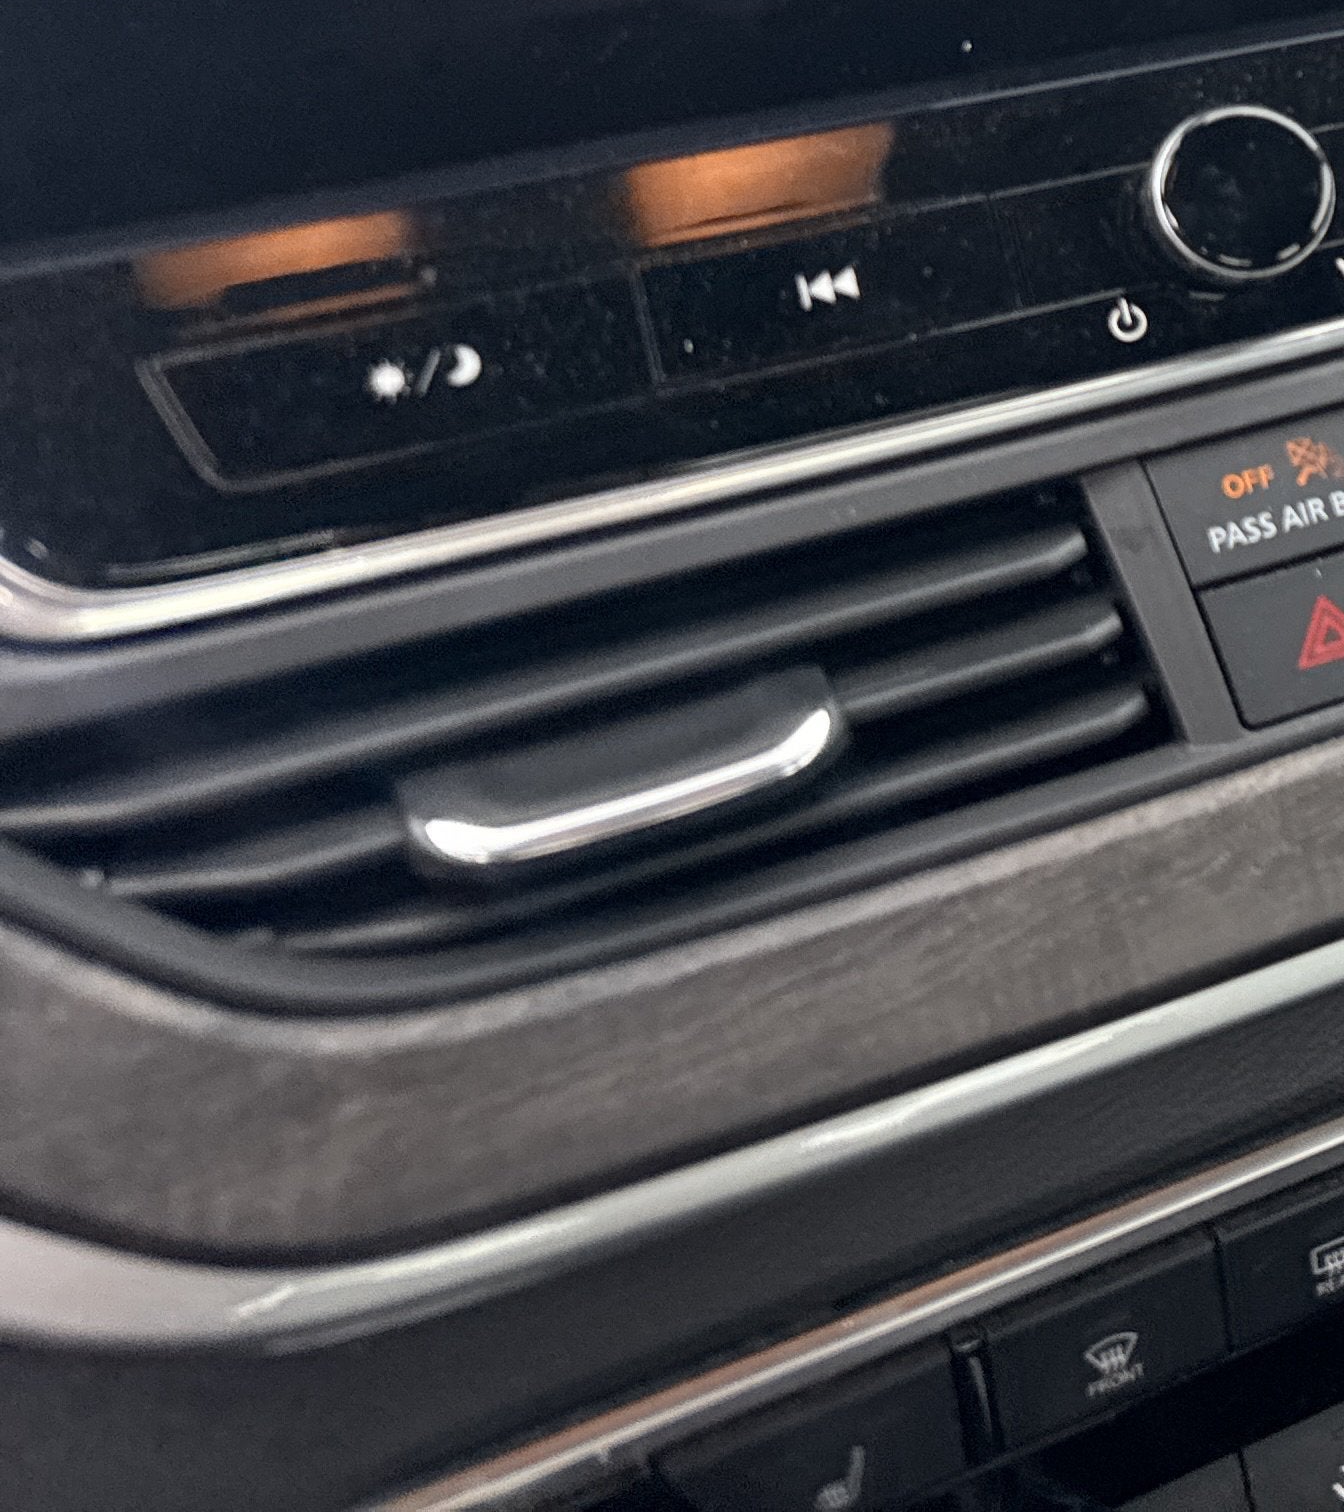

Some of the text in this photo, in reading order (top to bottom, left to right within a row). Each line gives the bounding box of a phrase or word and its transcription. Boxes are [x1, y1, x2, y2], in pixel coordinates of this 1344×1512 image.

[1221, 463, 1275, 500] OFF
[1206, 511, 1278, 554] PASS
[1282, 496, 1329, 534] AIR
